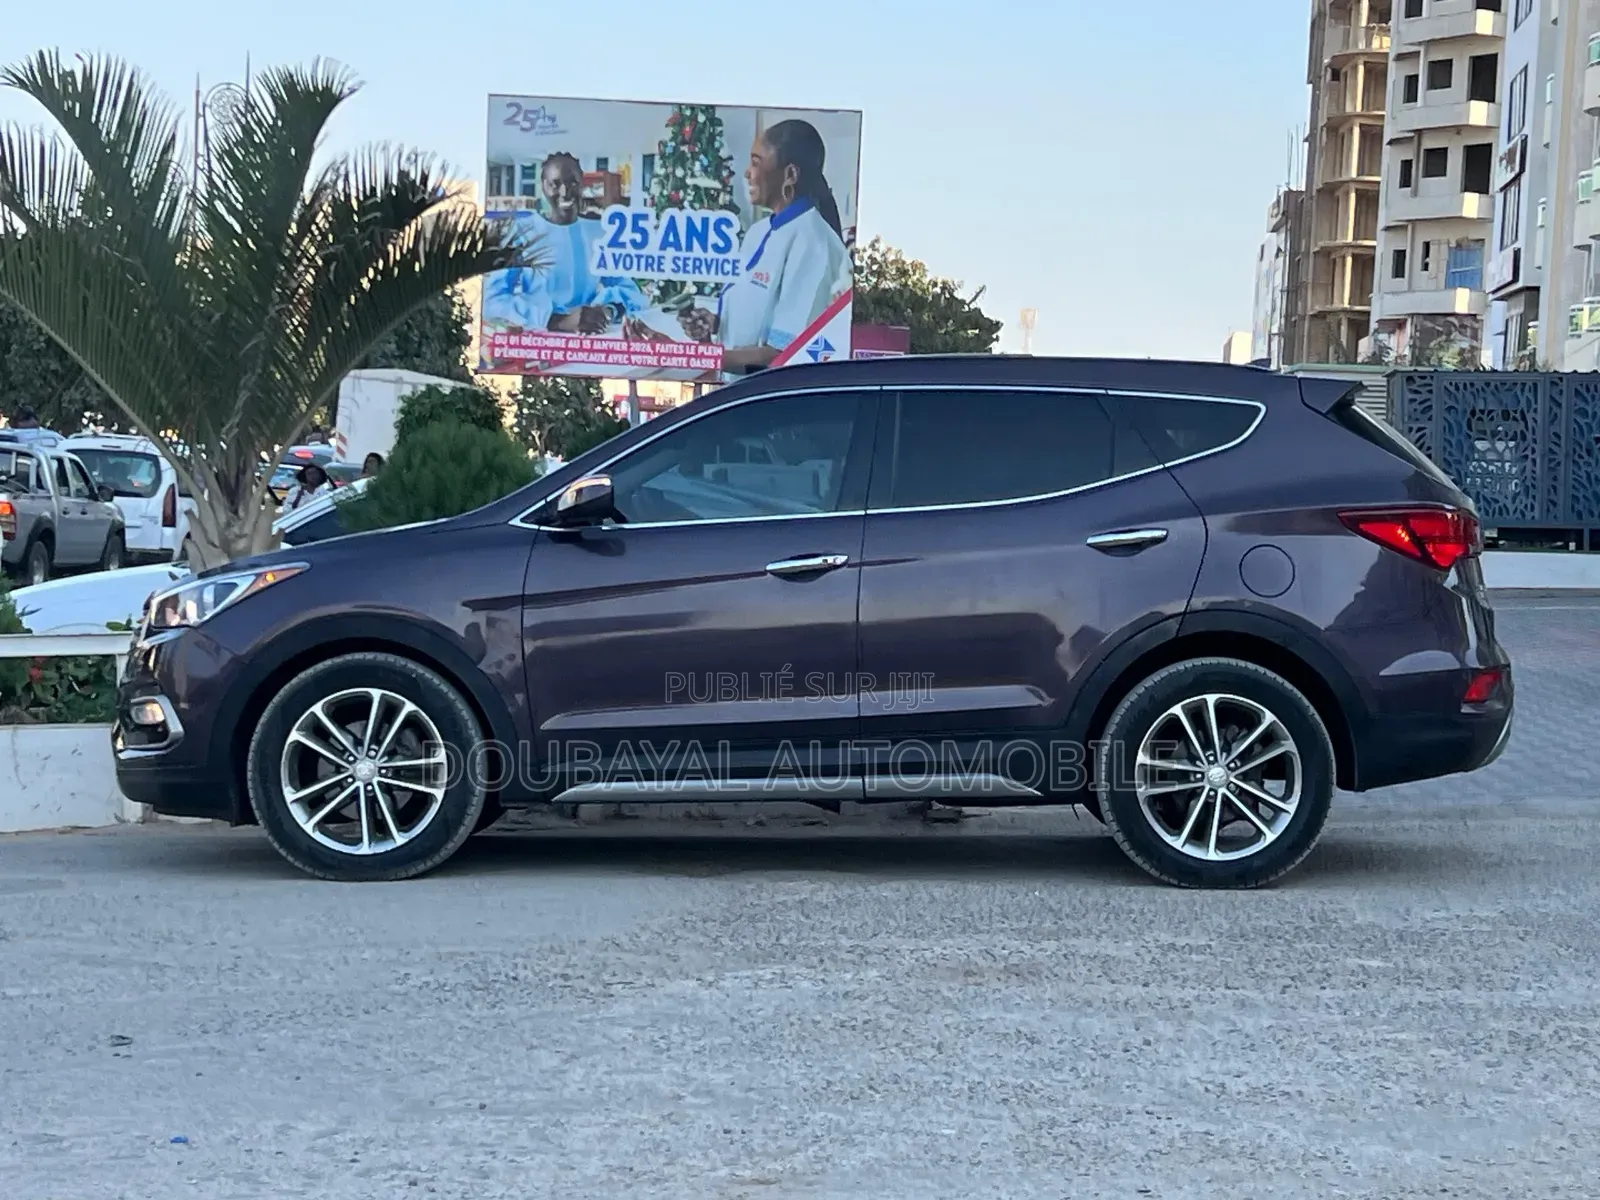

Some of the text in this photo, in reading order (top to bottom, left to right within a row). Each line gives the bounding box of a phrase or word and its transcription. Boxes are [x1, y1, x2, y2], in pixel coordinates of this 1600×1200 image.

[607, 212, 734, 254] 25 ANS
[596, 245, 741, 277] À VOTRE SERVICE
[521, 333, 566, 348] DÉCEMBRE
[568, 339, 580, 349] AU
[592, 340, 628, 351] JANVIER
[655, 343, 685, 354] FAITES
[686, 344, 696, 355] LE
[697, 345, 722, 356] PLEIN
[540, 349, 552, 360] ET
[553, 350, 565, 361] DE
[566, 351, 605, 362] CADEAUX
[608, 353, 629, 364] AVEC
[630, 354, 659, 366] VOTRE
[660, 356, 687, 368] CARTE
